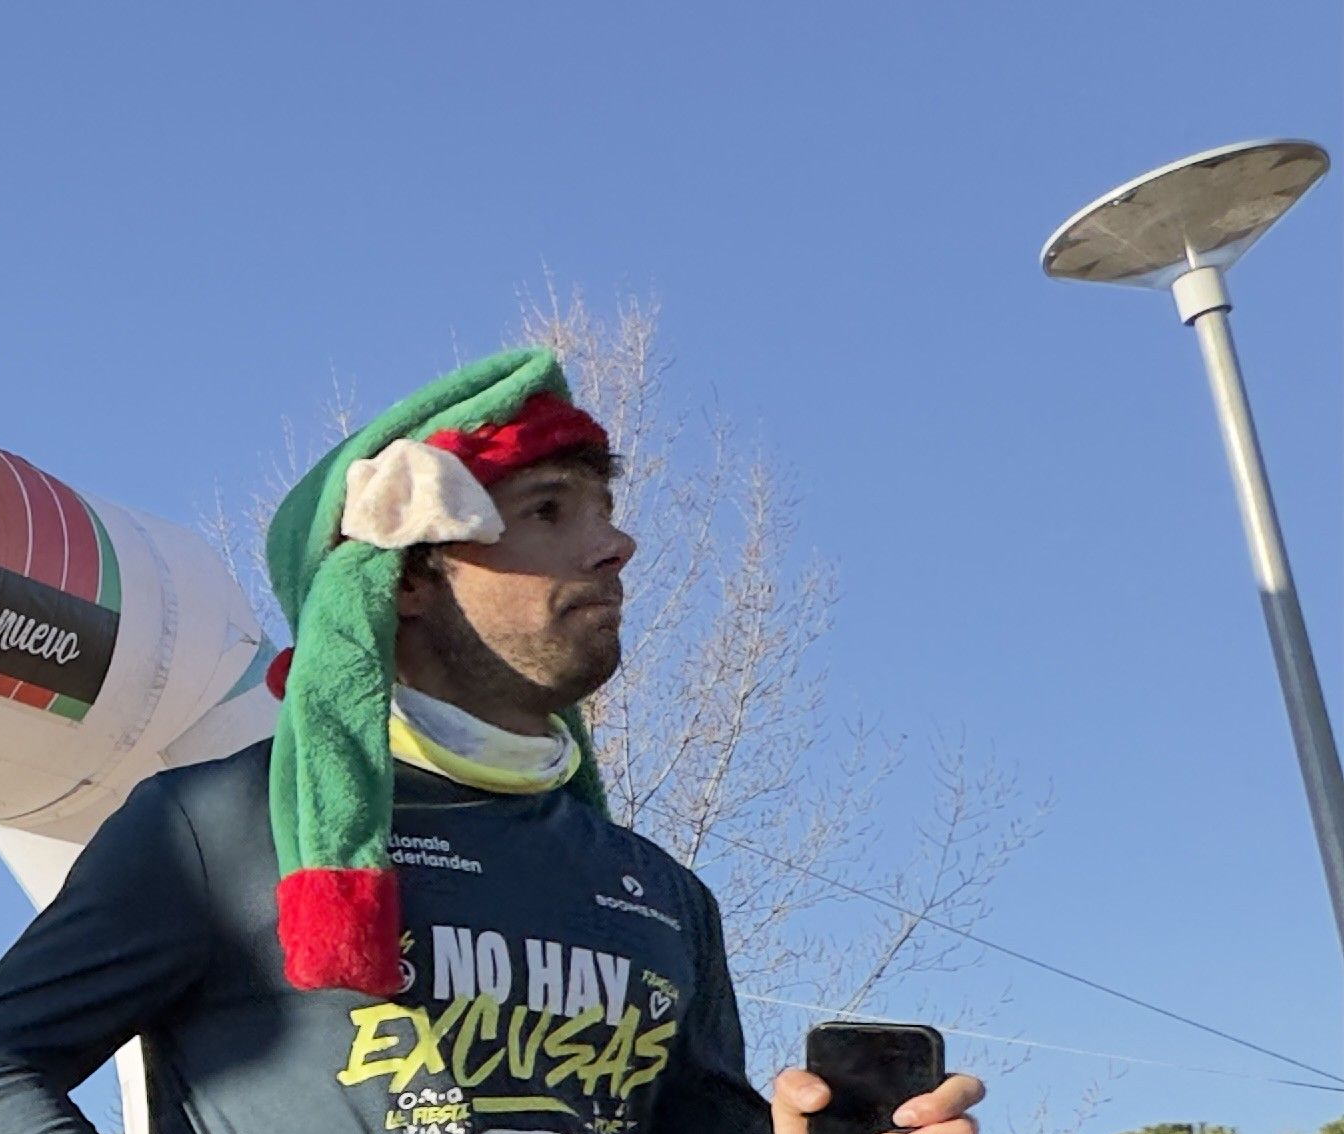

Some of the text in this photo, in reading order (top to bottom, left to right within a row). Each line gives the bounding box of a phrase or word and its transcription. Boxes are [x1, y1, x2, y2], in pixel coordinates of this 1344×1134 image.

[388, 834, 450, 852] tionale
[392, 848, 483, 874] derlanden
[432, 925, 631, 1026] NO HAY
[336, 993, 677, 1100] EXCUSAS
